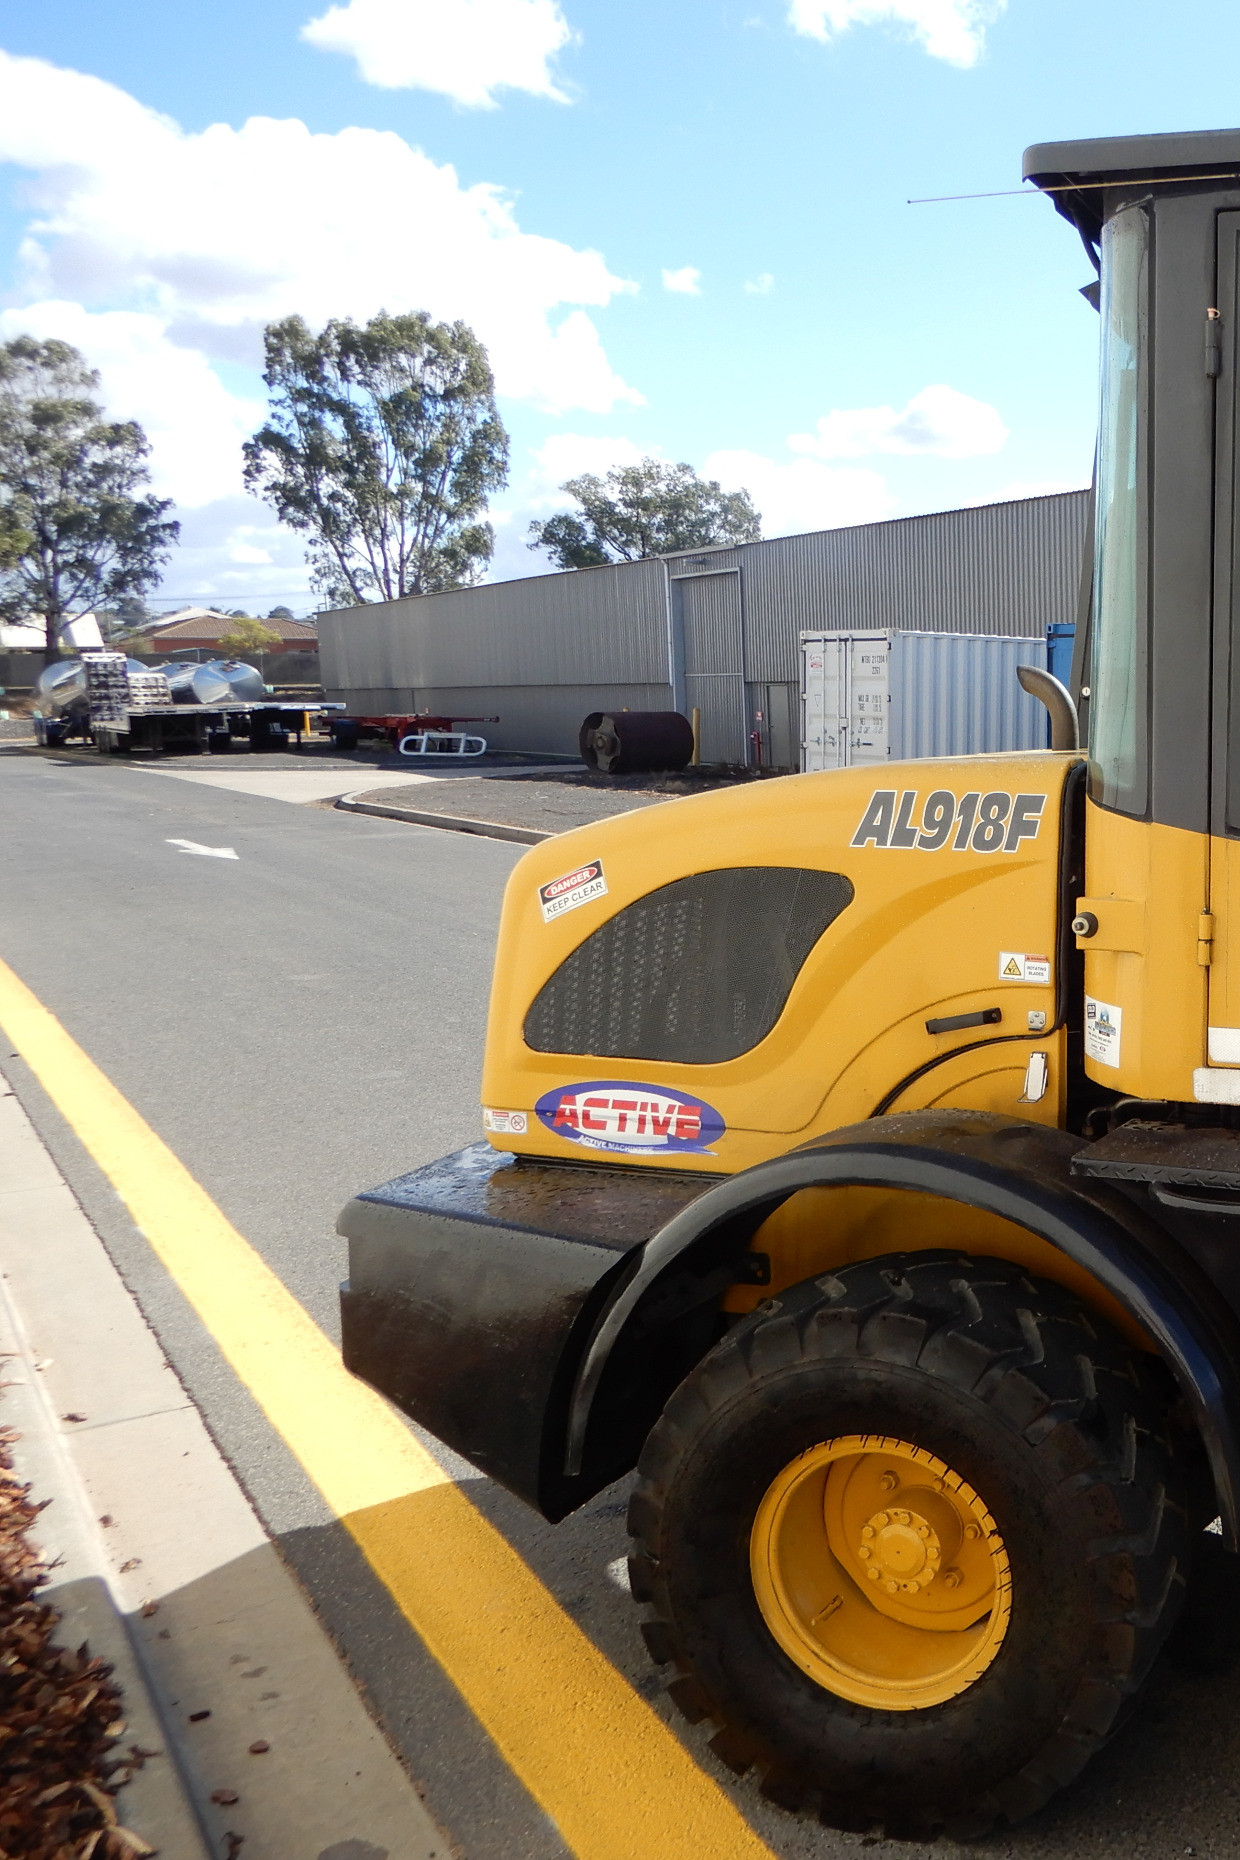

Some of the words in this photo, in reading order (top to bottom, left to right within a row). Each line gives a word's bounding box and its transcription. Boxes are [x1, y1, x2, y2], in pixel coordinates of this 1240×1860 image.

[849, 790, 1048, 853] AL918F
[546, 897, 569, 915] KEEP
[571, 881, 603, 902] CLEAR
[550, 870, 591, 896] DANGER
[553, 1094, 702, 1140] ACTIVE
[579, 1134, 607, 1148] ACTIVE
